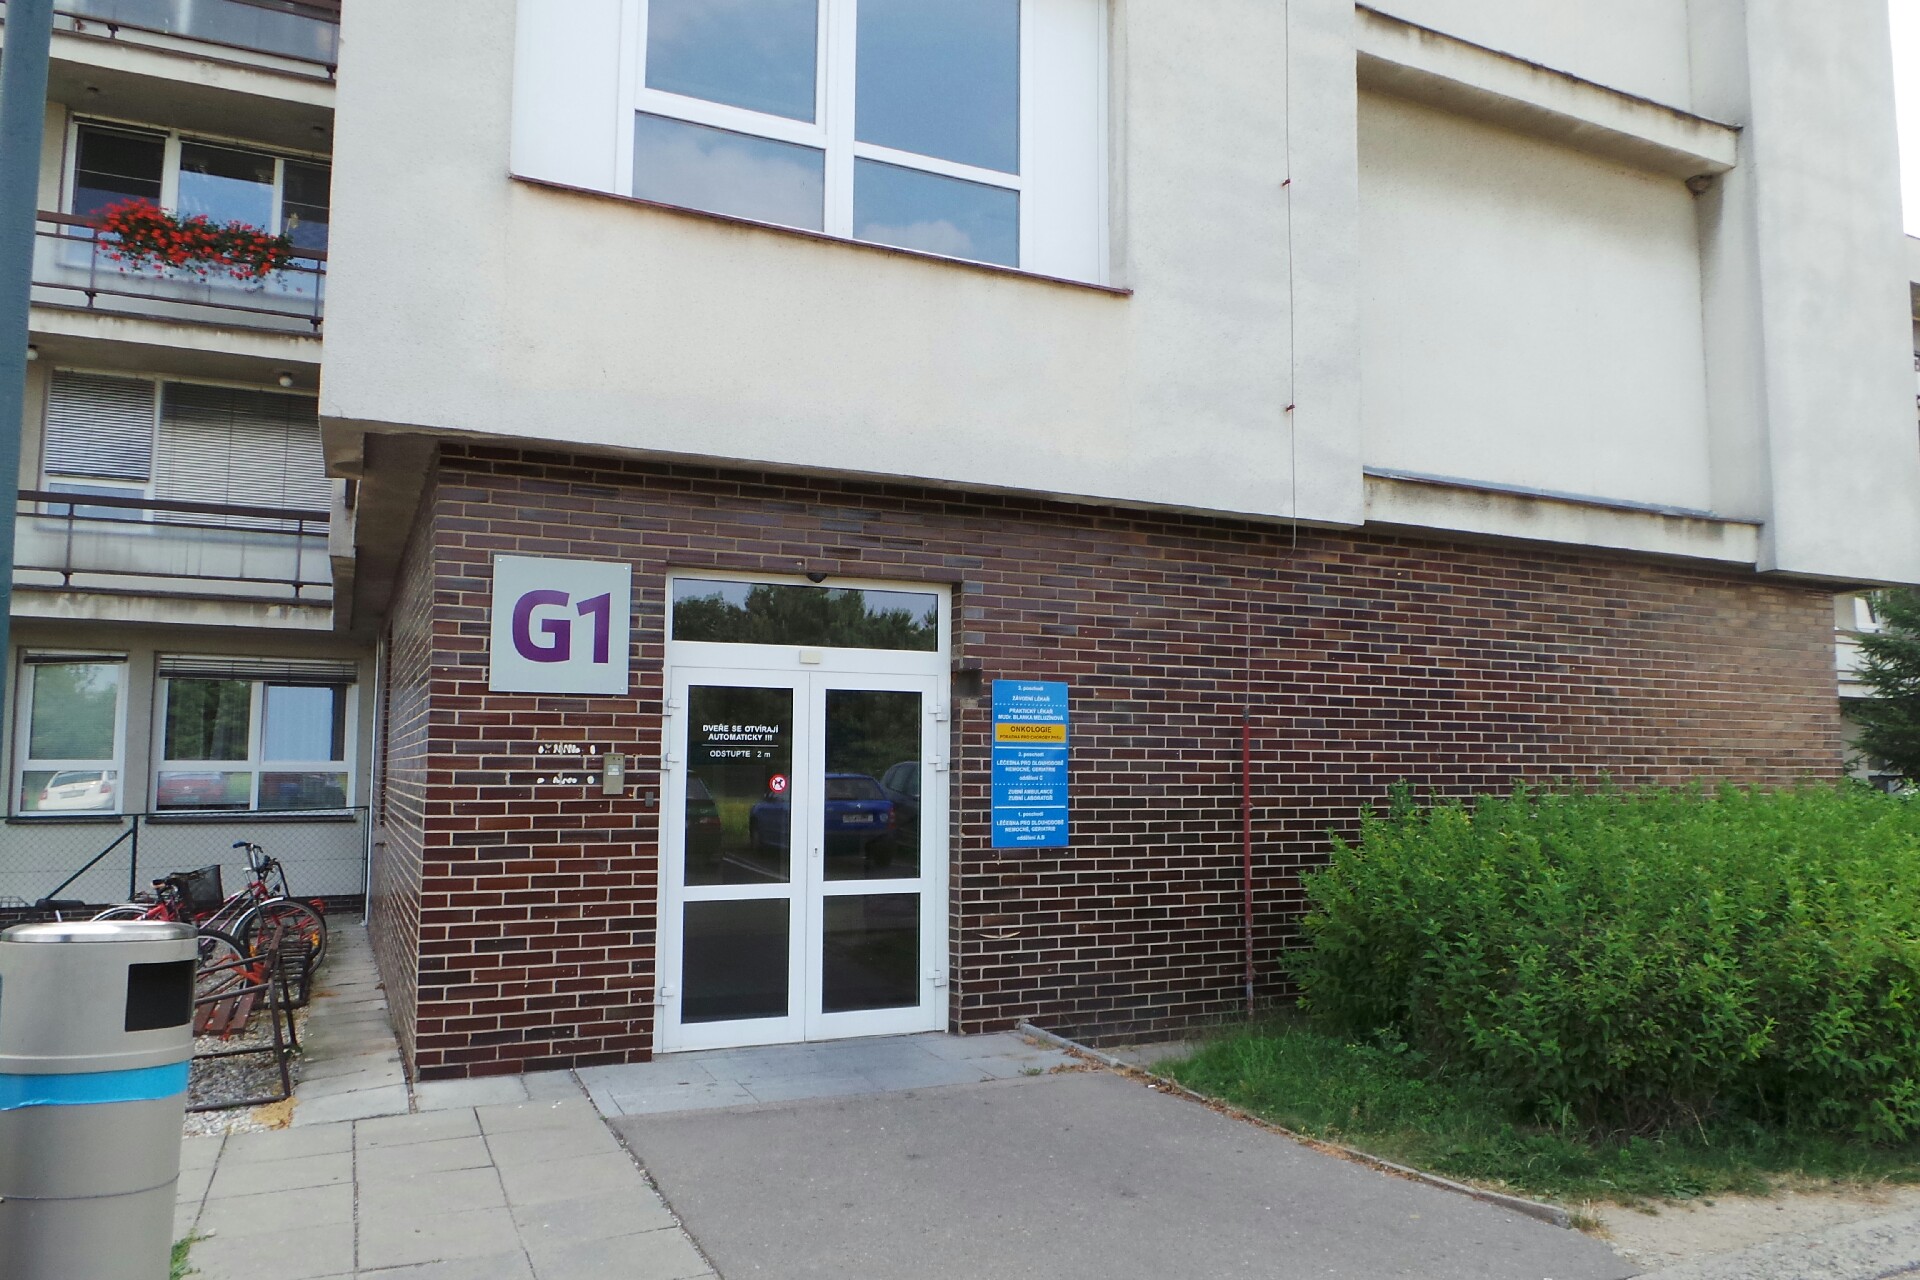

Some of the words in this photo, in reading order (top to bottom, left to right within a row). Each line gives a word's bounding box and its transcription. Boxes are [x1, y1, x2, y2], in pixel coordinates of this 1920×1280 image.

[512, 590, 610, 664] G1
[703, 724, 728, 732] DVEŘE
[744, 725, 778, 733] OTVÍRAJÍ
